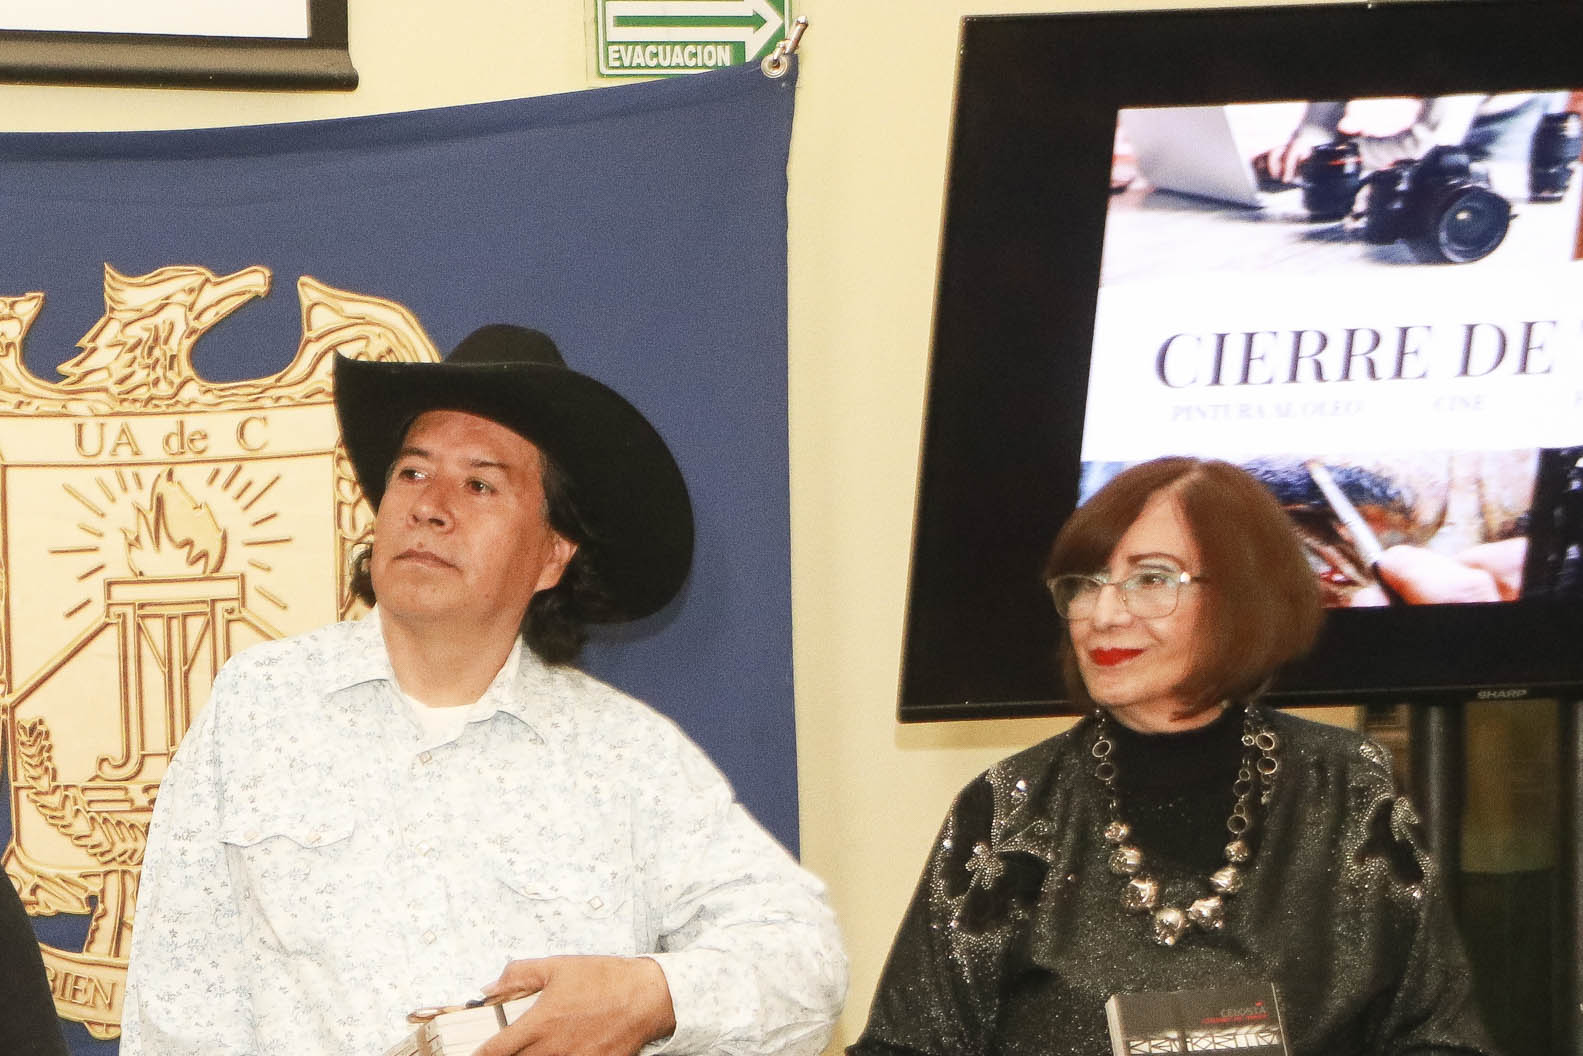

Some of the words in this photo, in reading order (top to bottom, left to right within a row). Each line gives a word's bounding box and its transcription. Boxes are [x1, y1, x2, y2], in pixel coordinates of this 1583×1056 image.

[608, 45, 731, 68] EVACUACION
[1154, 324, 1433, 389] CIERRE
[1453, 320, 1558, 379] DE
[1431, 393, 1488, 414] CINE
[74, 421, 142, 457] UA
[162, 420, 208, 455] de
[236, 416, 270, 451] C
[1477, 689, 1527, 699] SHARP
